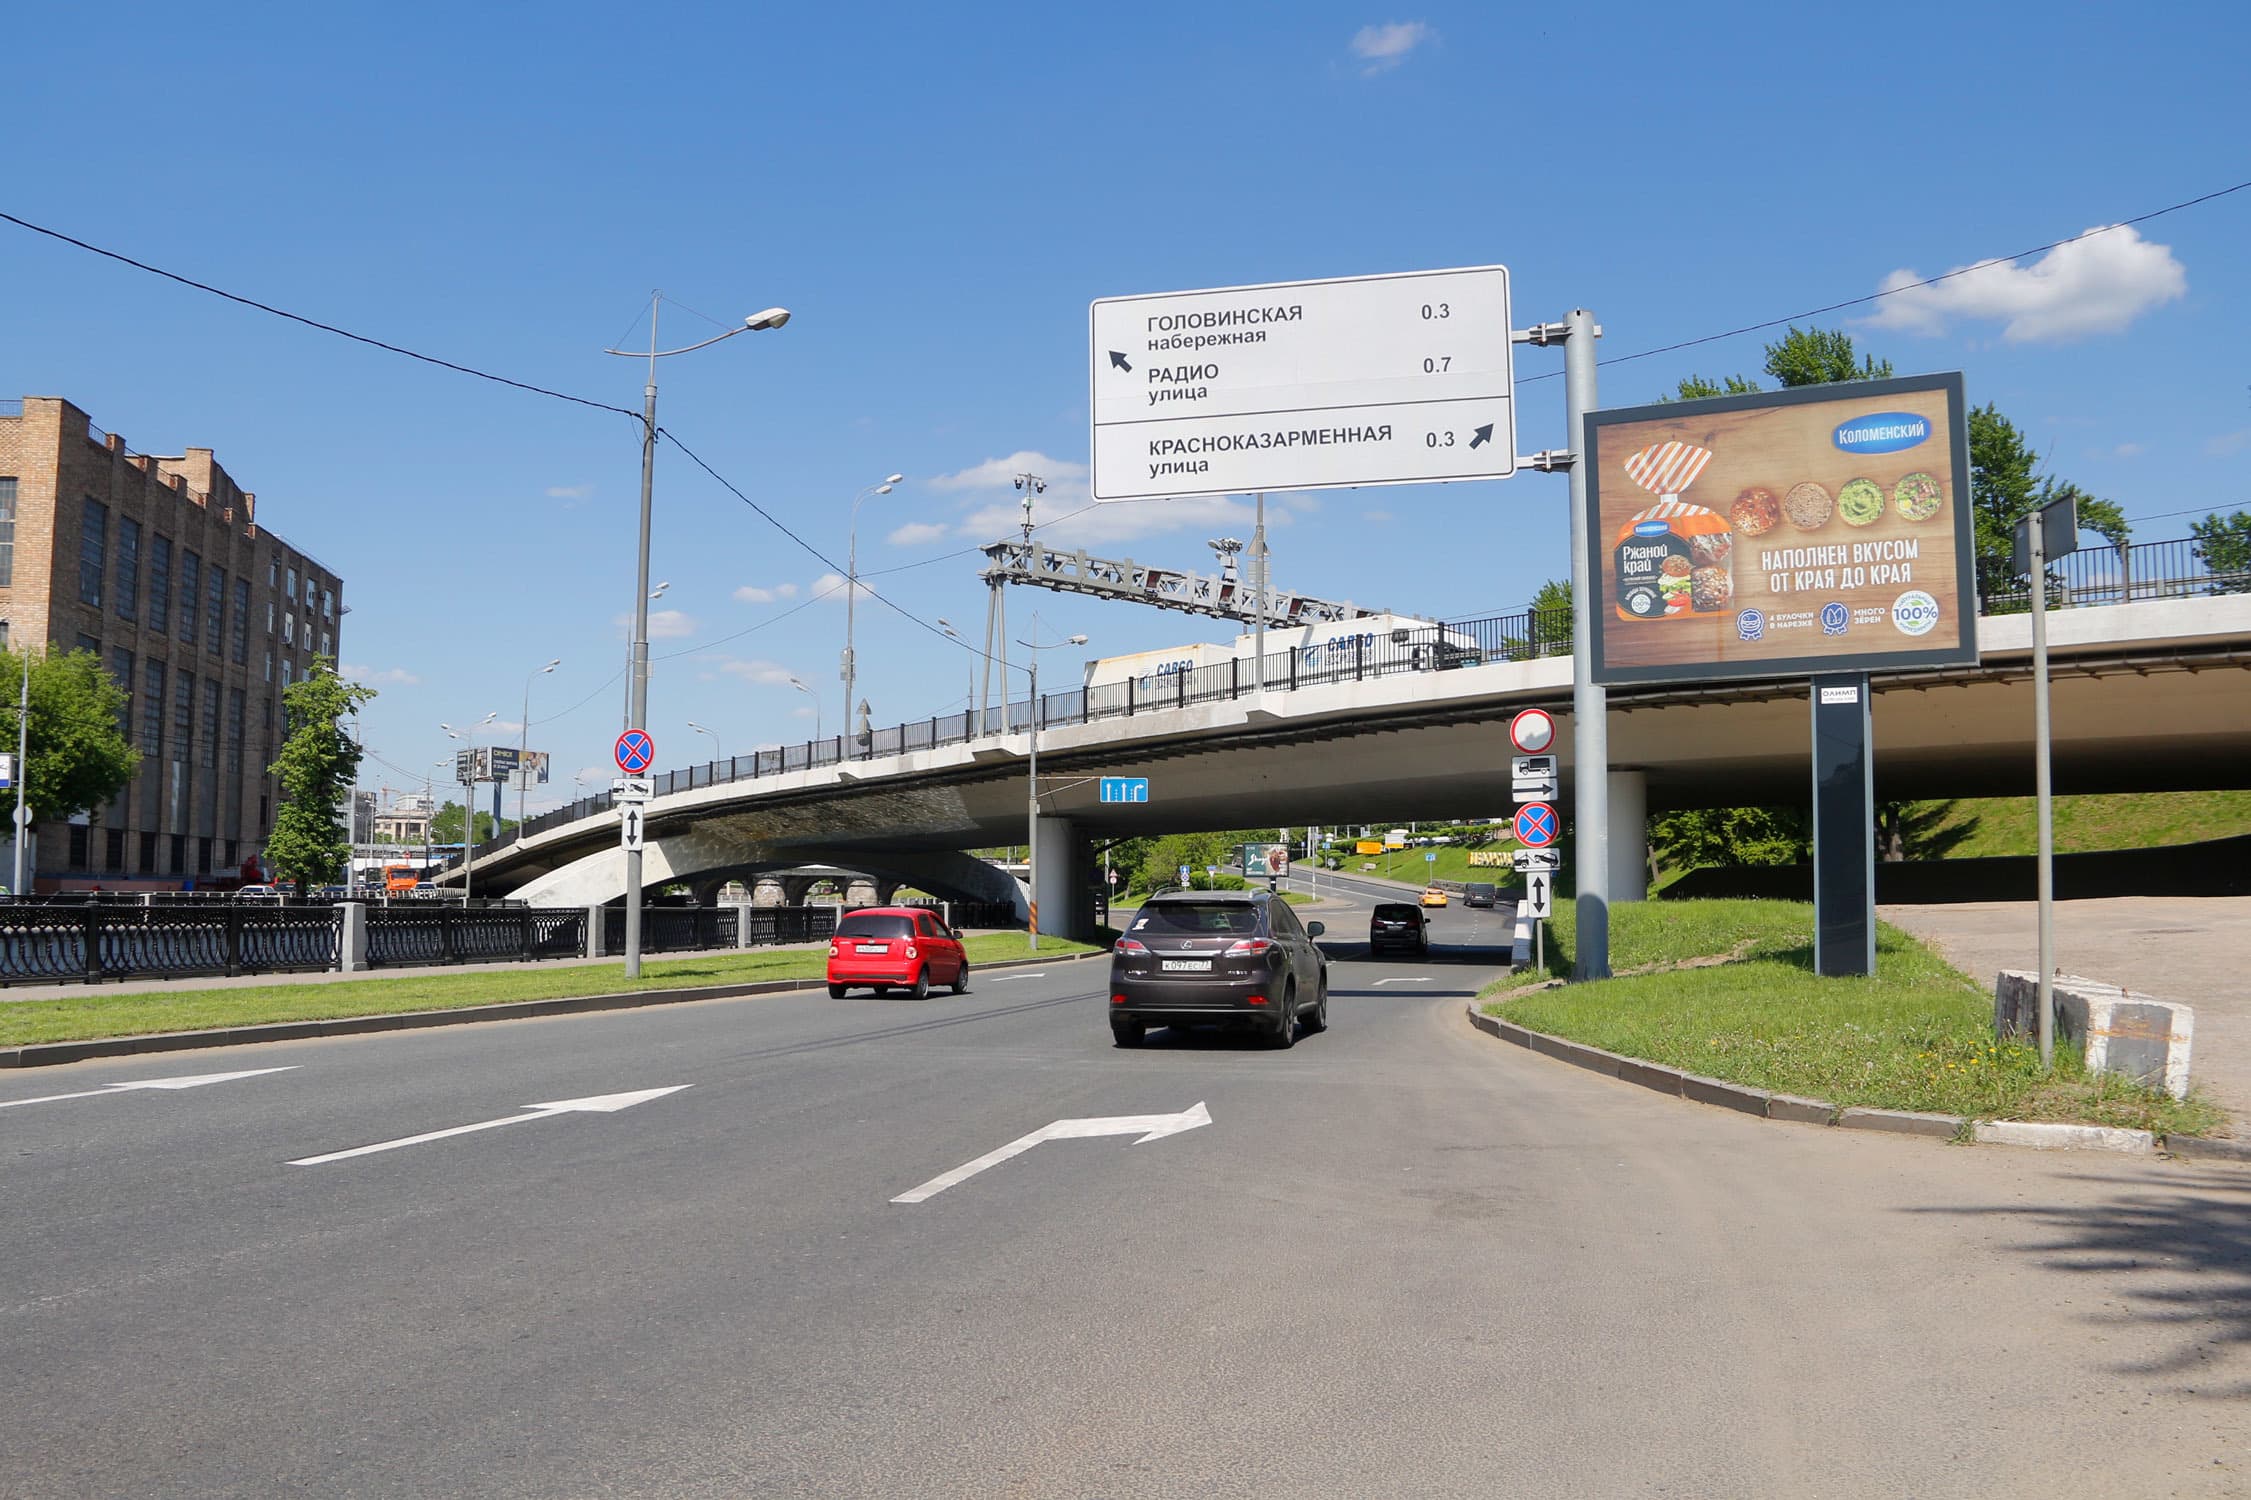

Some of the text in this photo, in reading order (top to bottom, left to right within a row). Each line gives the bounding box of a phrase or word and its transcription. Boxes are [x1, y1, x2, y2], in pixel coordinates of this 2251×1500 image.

[1148, 305, 1302, 332] ГОЛОВИНСКАЯ
[1421, 303, 1450, 320] 0.3
[1148, 330, 1266, 351] набережная
[1148, 363, 1219, 384] РАДИО
[1423, 356, 1452, 374] 0.7
[1148, 386, 1208, 406] улица
[1149, 424, 1455, 456] КРАСНОКАЗАРМЕННАЯ 0.3
[1149, 460, 1209, 480] улица
[1623, 543, 1668, 560] Ржаной
[1762, 538, 1919, 571] НАПОЛНЕН ВКУСОМ
[1623, 559, 1651, 575] край
[1770, 562, 1912, 593] ОТ КРАЯ ДО КРАЯ
[1853, 607, 1886, 616] МНОГО
[1893, 606, 1938, 621] 100%
